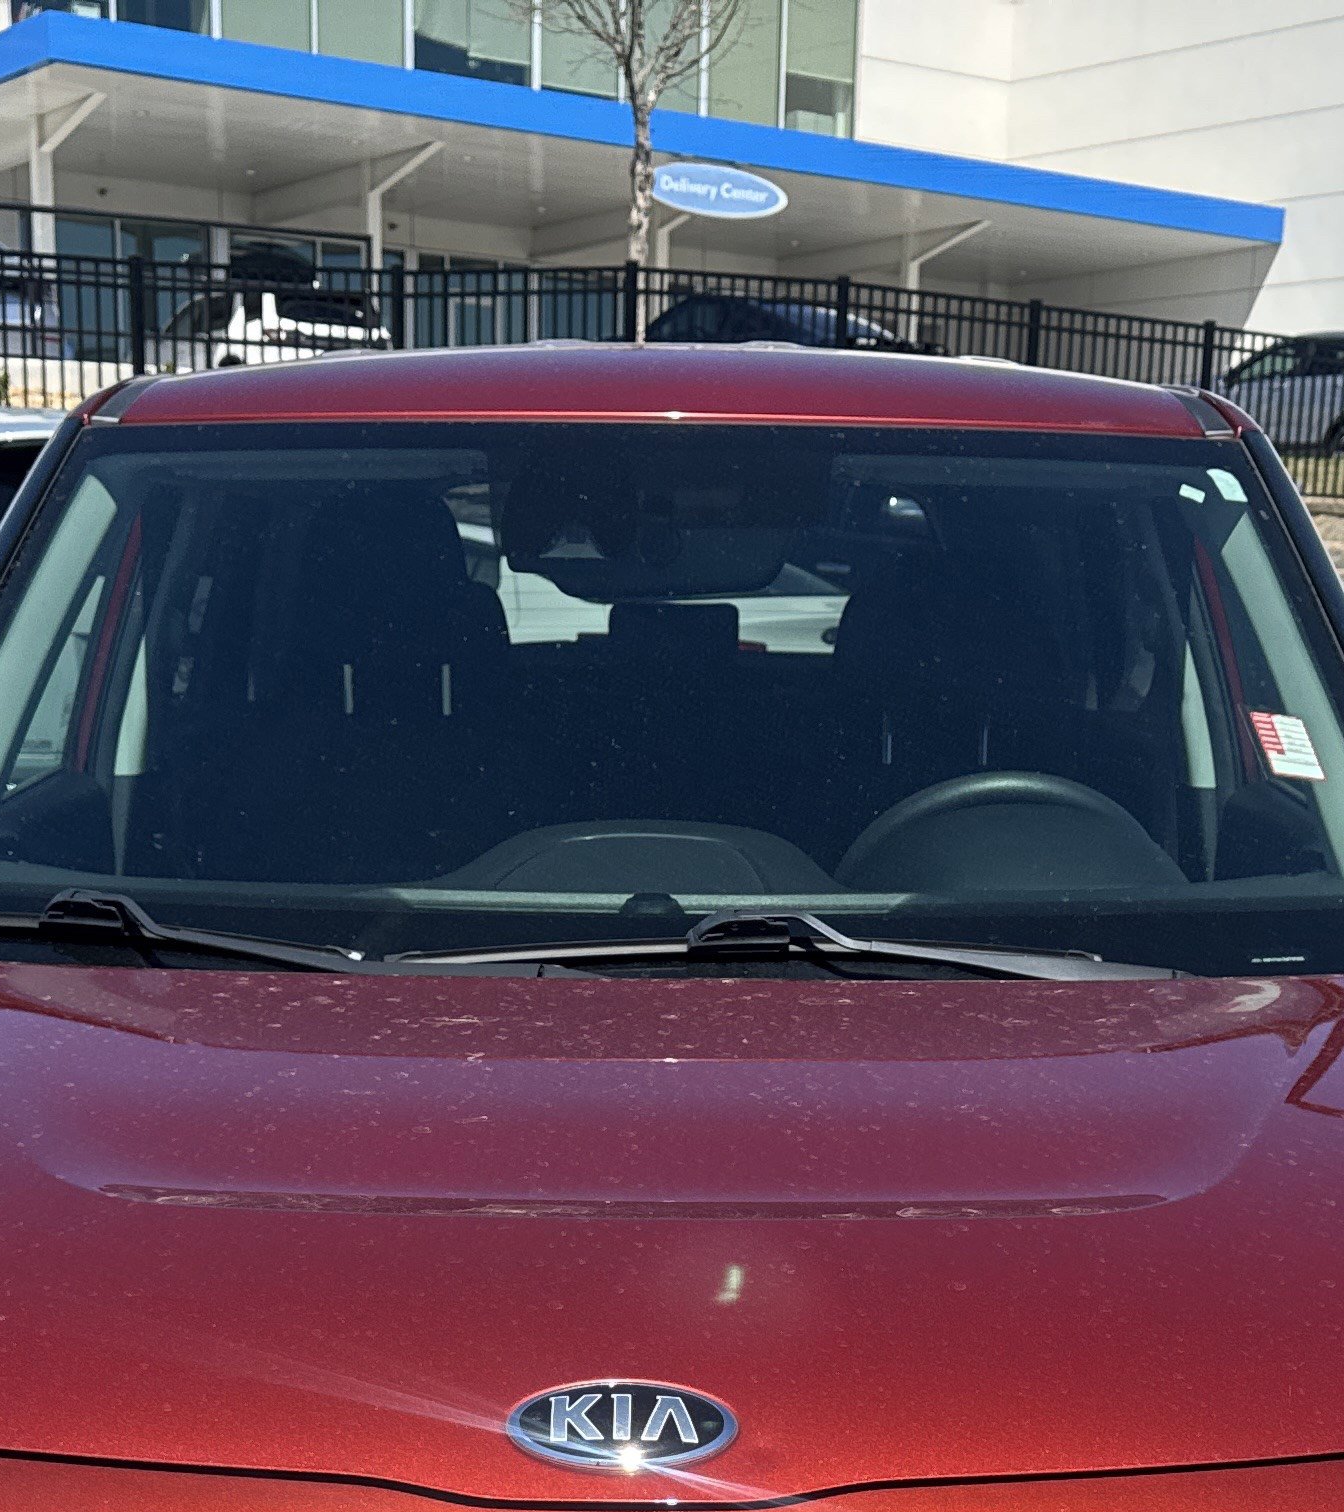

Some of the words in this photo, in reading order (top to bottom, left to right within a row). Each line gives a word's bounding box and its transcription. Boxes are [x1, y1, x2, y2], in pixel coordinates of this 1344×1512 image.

[659, 174, 718, 202] Delivery
[720, 182, 769, 204] Center
[549, 1393, 699, 1444] KIA
